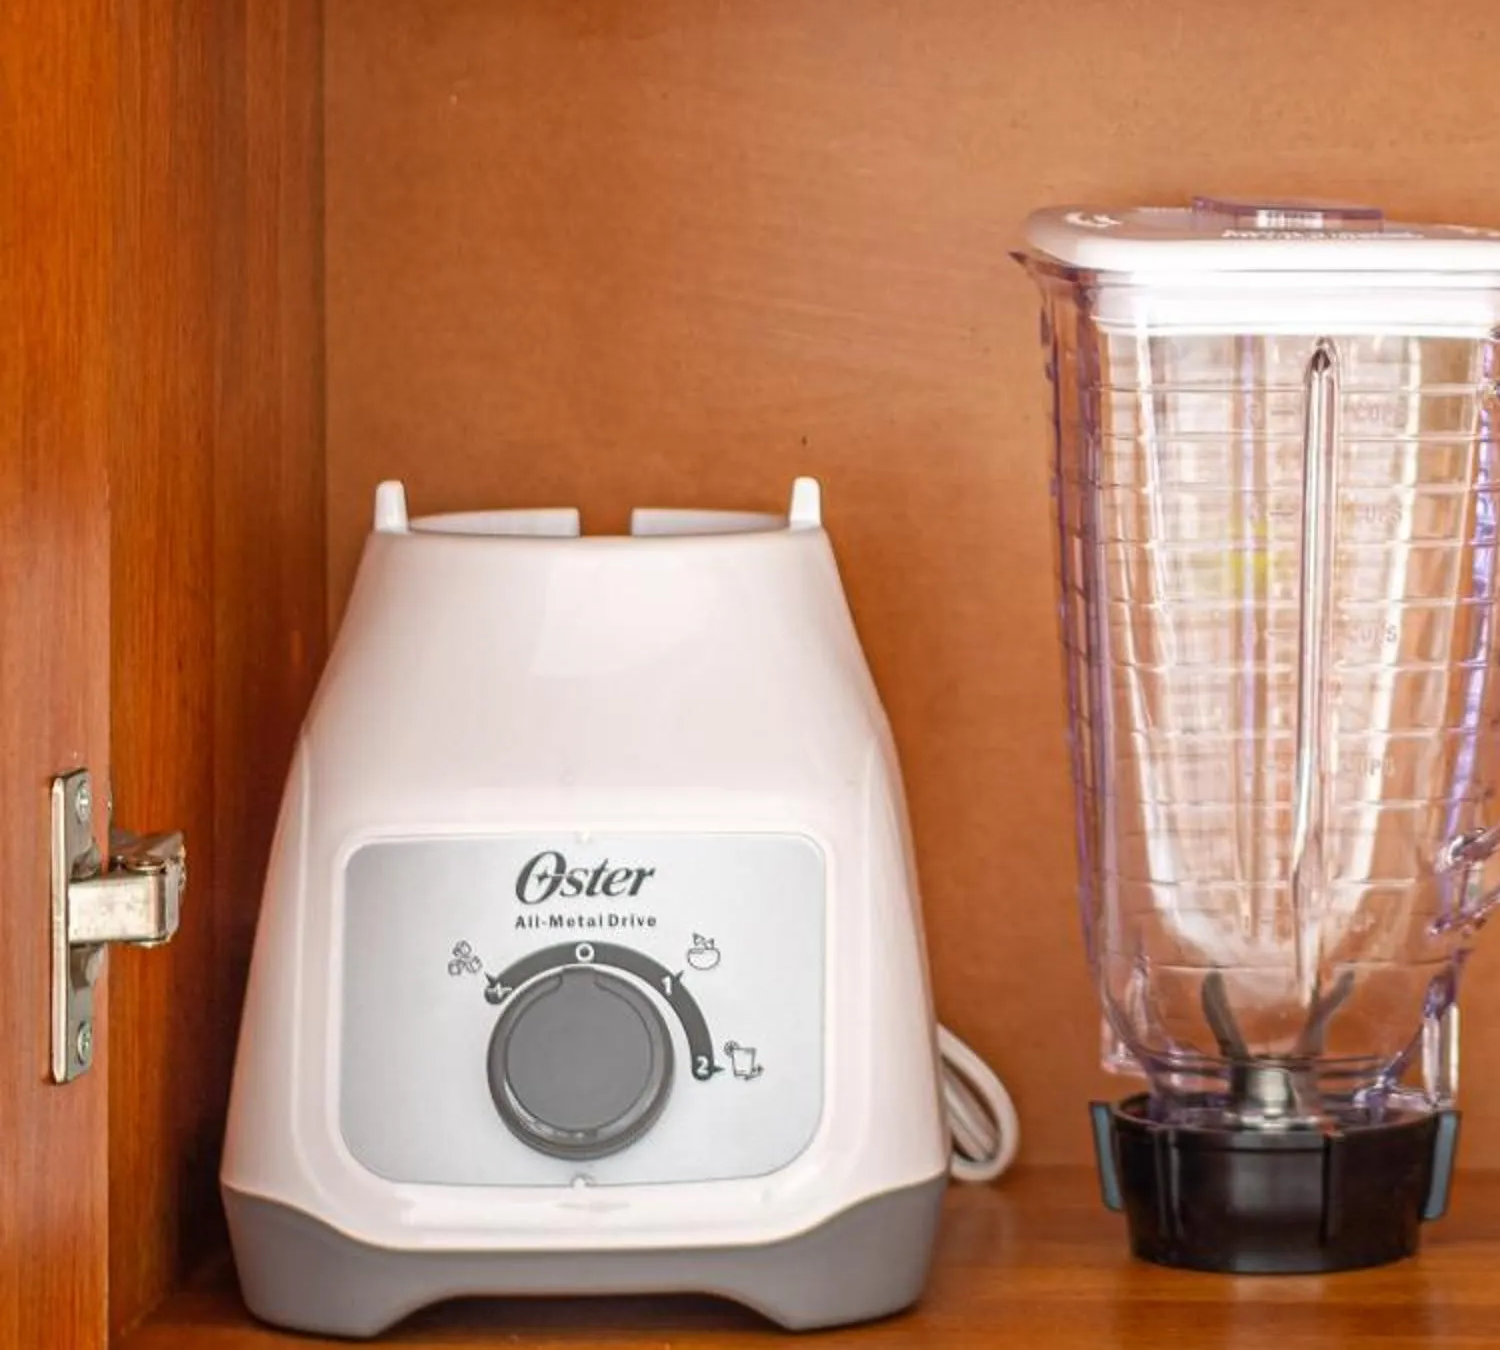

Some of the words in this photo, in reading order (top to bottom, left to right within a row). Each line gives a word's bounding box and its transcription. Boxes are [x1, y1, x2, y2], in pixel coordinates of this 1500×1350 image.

[515, 850, 656, 905] Oster
[608, 913, 657, 928] Drive
[661, 975, 674, 996] 1
[696, 1055, 709, 1072] 2
